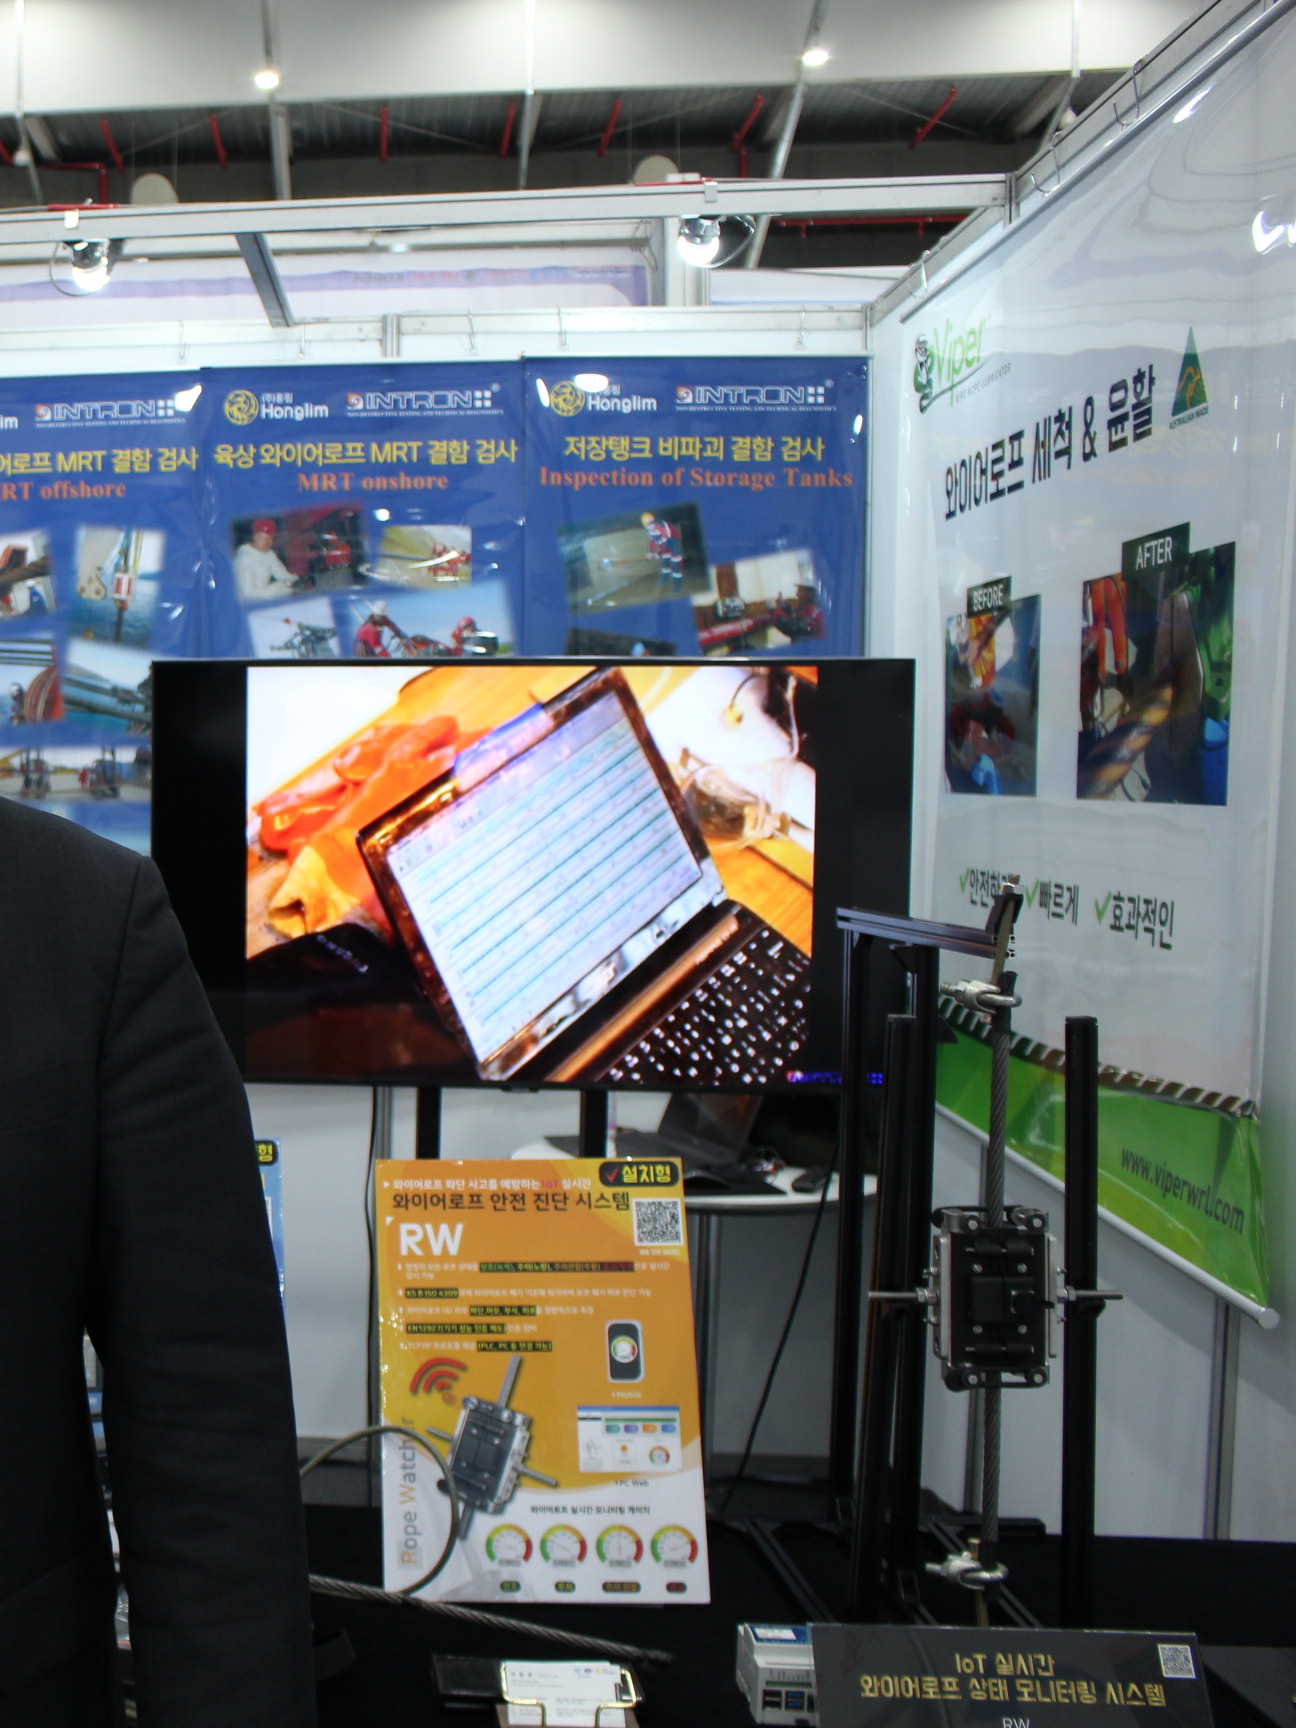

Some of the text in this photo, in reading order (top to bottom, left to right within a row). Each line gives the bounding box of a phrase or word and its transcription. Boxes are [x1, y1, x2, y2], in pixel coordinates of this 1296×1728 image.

[934, 317, 988, 406] Viper
[365, 390, 473, 410] INTRON
[588, 395, 657, 413] Honglim
[696, 385, 804, 404] INTRON
[54, 400, 156, 422] INTRON
[260, 402, 329, 421] Honglim
[1195, 405, 1209, 420] MADE
[214, 439, 518, 469] 육상 와이어로프 MRT 결함 검사
[564, 436, 825, 462] 저장탱크 비파괴 결함 검사
[945, 364, 1155, 520] 와이어로프 세척 & 윤활
[56, 450, 107, 472] MRT
[112, 448, 153, 473] 결함
[158, 447, 198, 471] 검사
[41, 480, 126, 499] offshore
[298, 472, 449, 492] MRT onshore
[539, 466, 853, 491] Inspection of Storage Tanks
[1135, 536, 1173, 570] AFTER
[972, 583, 1004, 612] BEFORE
[969, 868, 1007, 910] 안전하
[1039, 880, 1079, 926] 빠르게
[1109, 892, 1175, 951] 효과적인
[393, 1179, 443, 1190] 와이어로프
[561, 1178, 591, 1189] 실시간
[622, 1165, 671, 1184] 설치형
[393, 1192, 630, 1212] 와이어로프 안전 진단 시스템
[1121, 1147, 1245, 1234] www.viperwrl.com
[399, 1222, 464, 1256] RW
[398, 1416, 422, 1564] Rope Watchr
[632, 1479, 649, 1487] Web
[955, 1653, 1055, 1677] IoT 실시간
[859, 1674, 1166, 1707] 와이어로프 상태 모니터링 시스템
